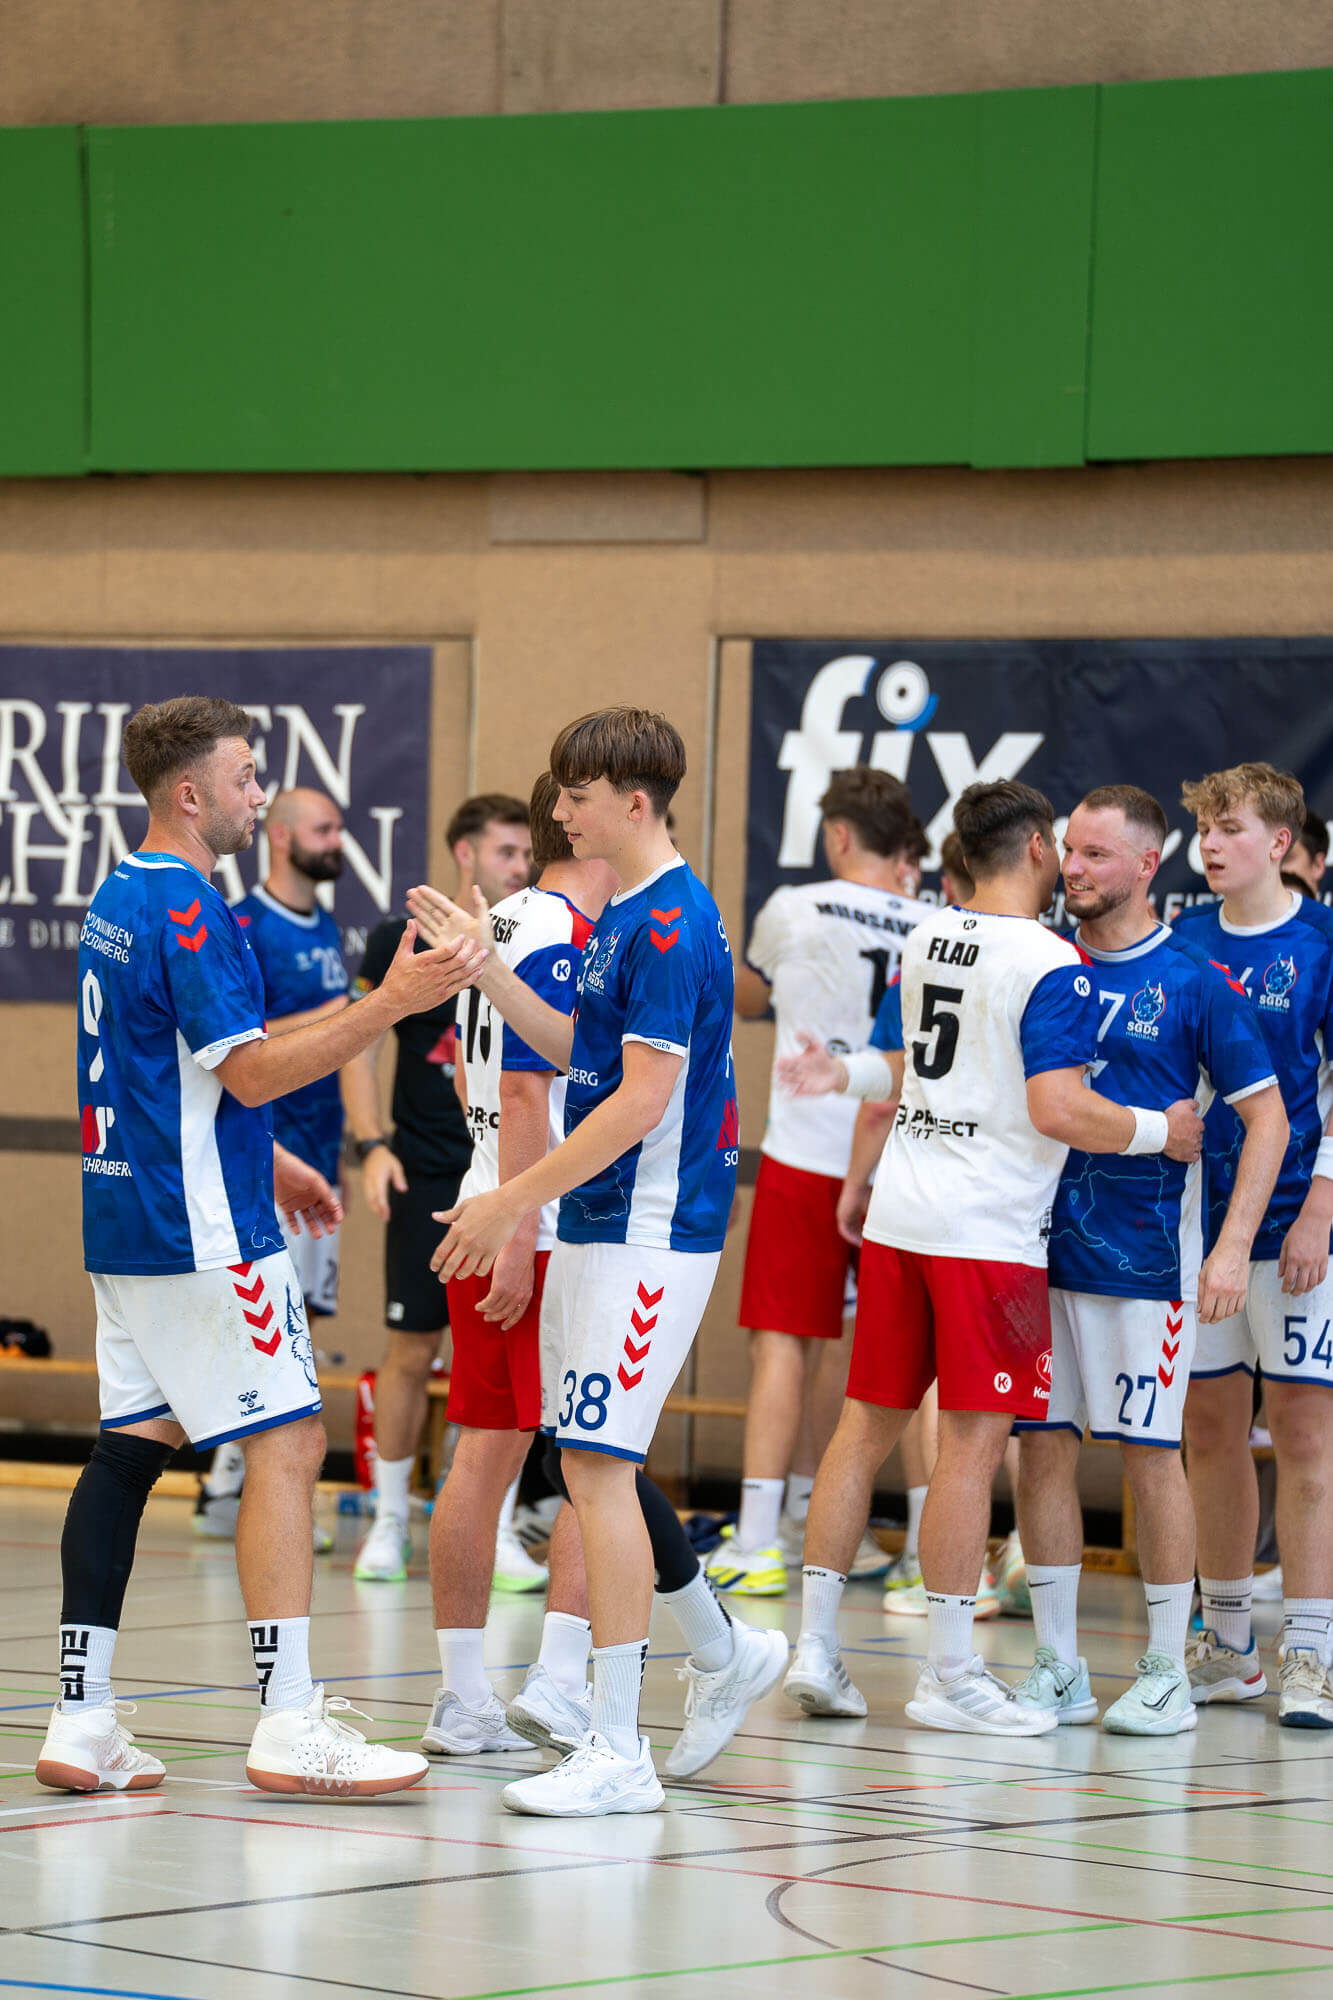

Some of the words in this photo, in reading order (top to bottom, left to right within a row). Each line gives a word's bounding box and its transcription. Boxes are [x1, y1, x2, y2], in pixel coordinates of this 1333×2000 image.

[777, 654, 1045, 870] fix
[927, 937, 980, 967] FLAD
[1127, 1021, 1159, 1036] SGDS
[1259, 995, 1290, 1009] SGDS
[912, 983, 964, 1081] 5
[1284, 1315, 1333, 1370] 54
[558, 1369, 612, 1431] 38
[1115, 1372, 1157, 1428] 27
